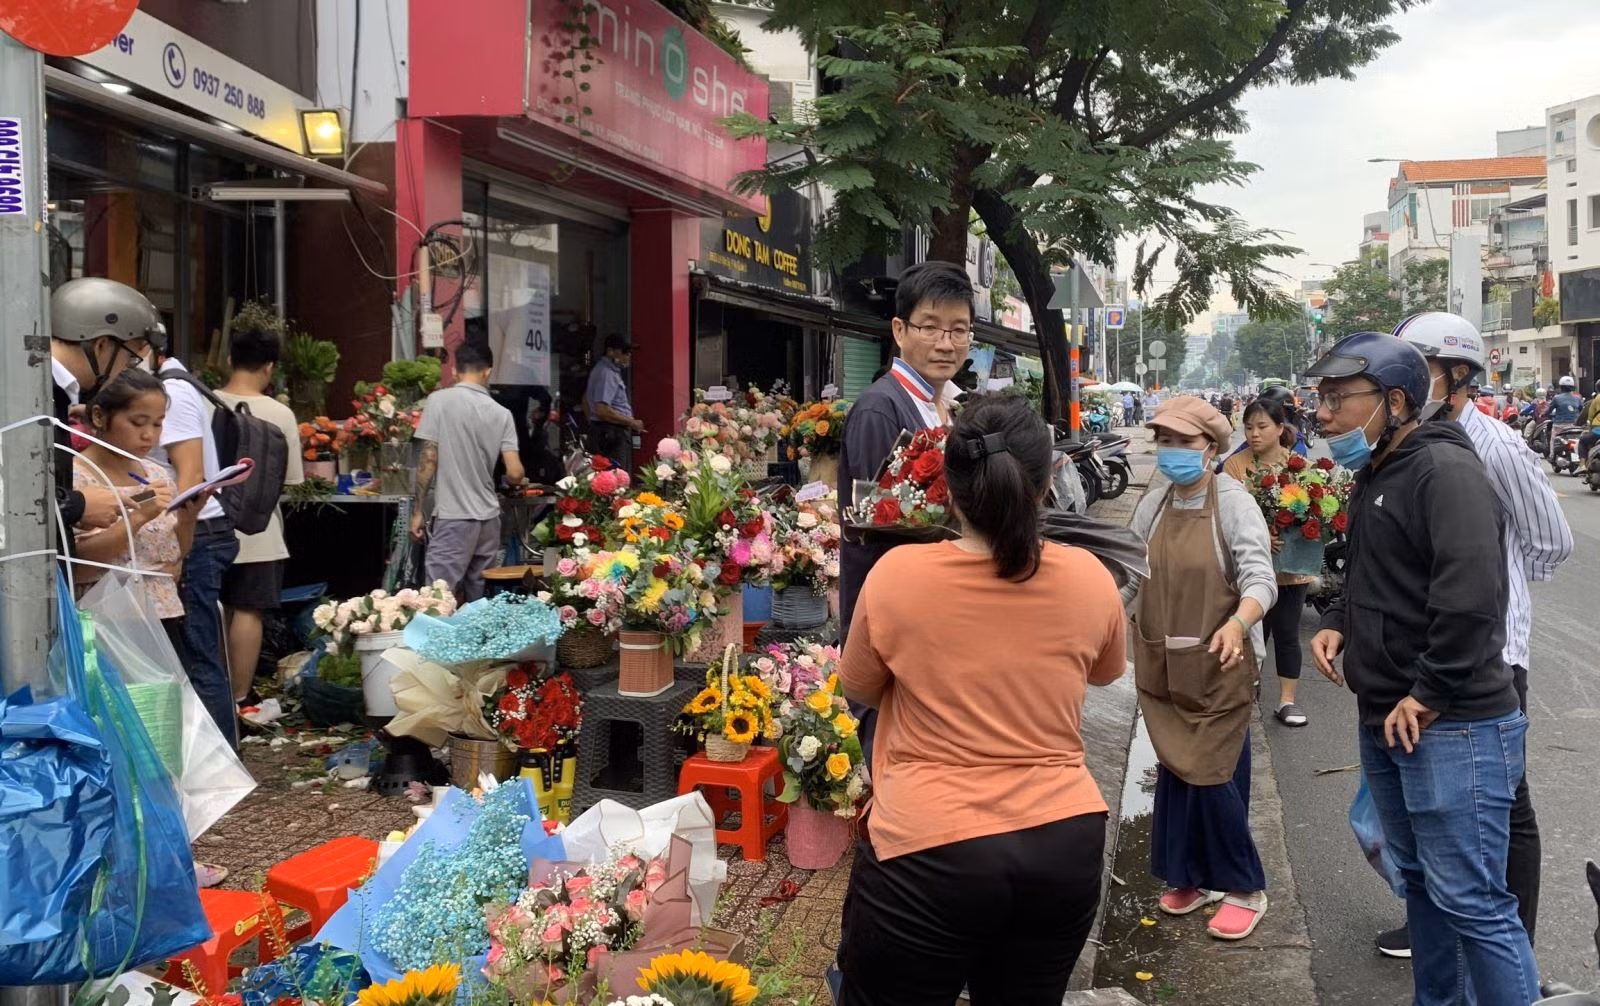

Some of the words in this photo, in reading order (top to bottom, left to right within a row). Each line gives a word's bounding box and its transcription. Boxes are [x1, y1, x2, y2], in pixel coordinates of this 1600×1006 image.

[193, 68, 220, 98] 0937
[224, 82, 244, 109] 250
[247, 94, 265, 119] 888
[773, 249, 798, 276] COFFEE
